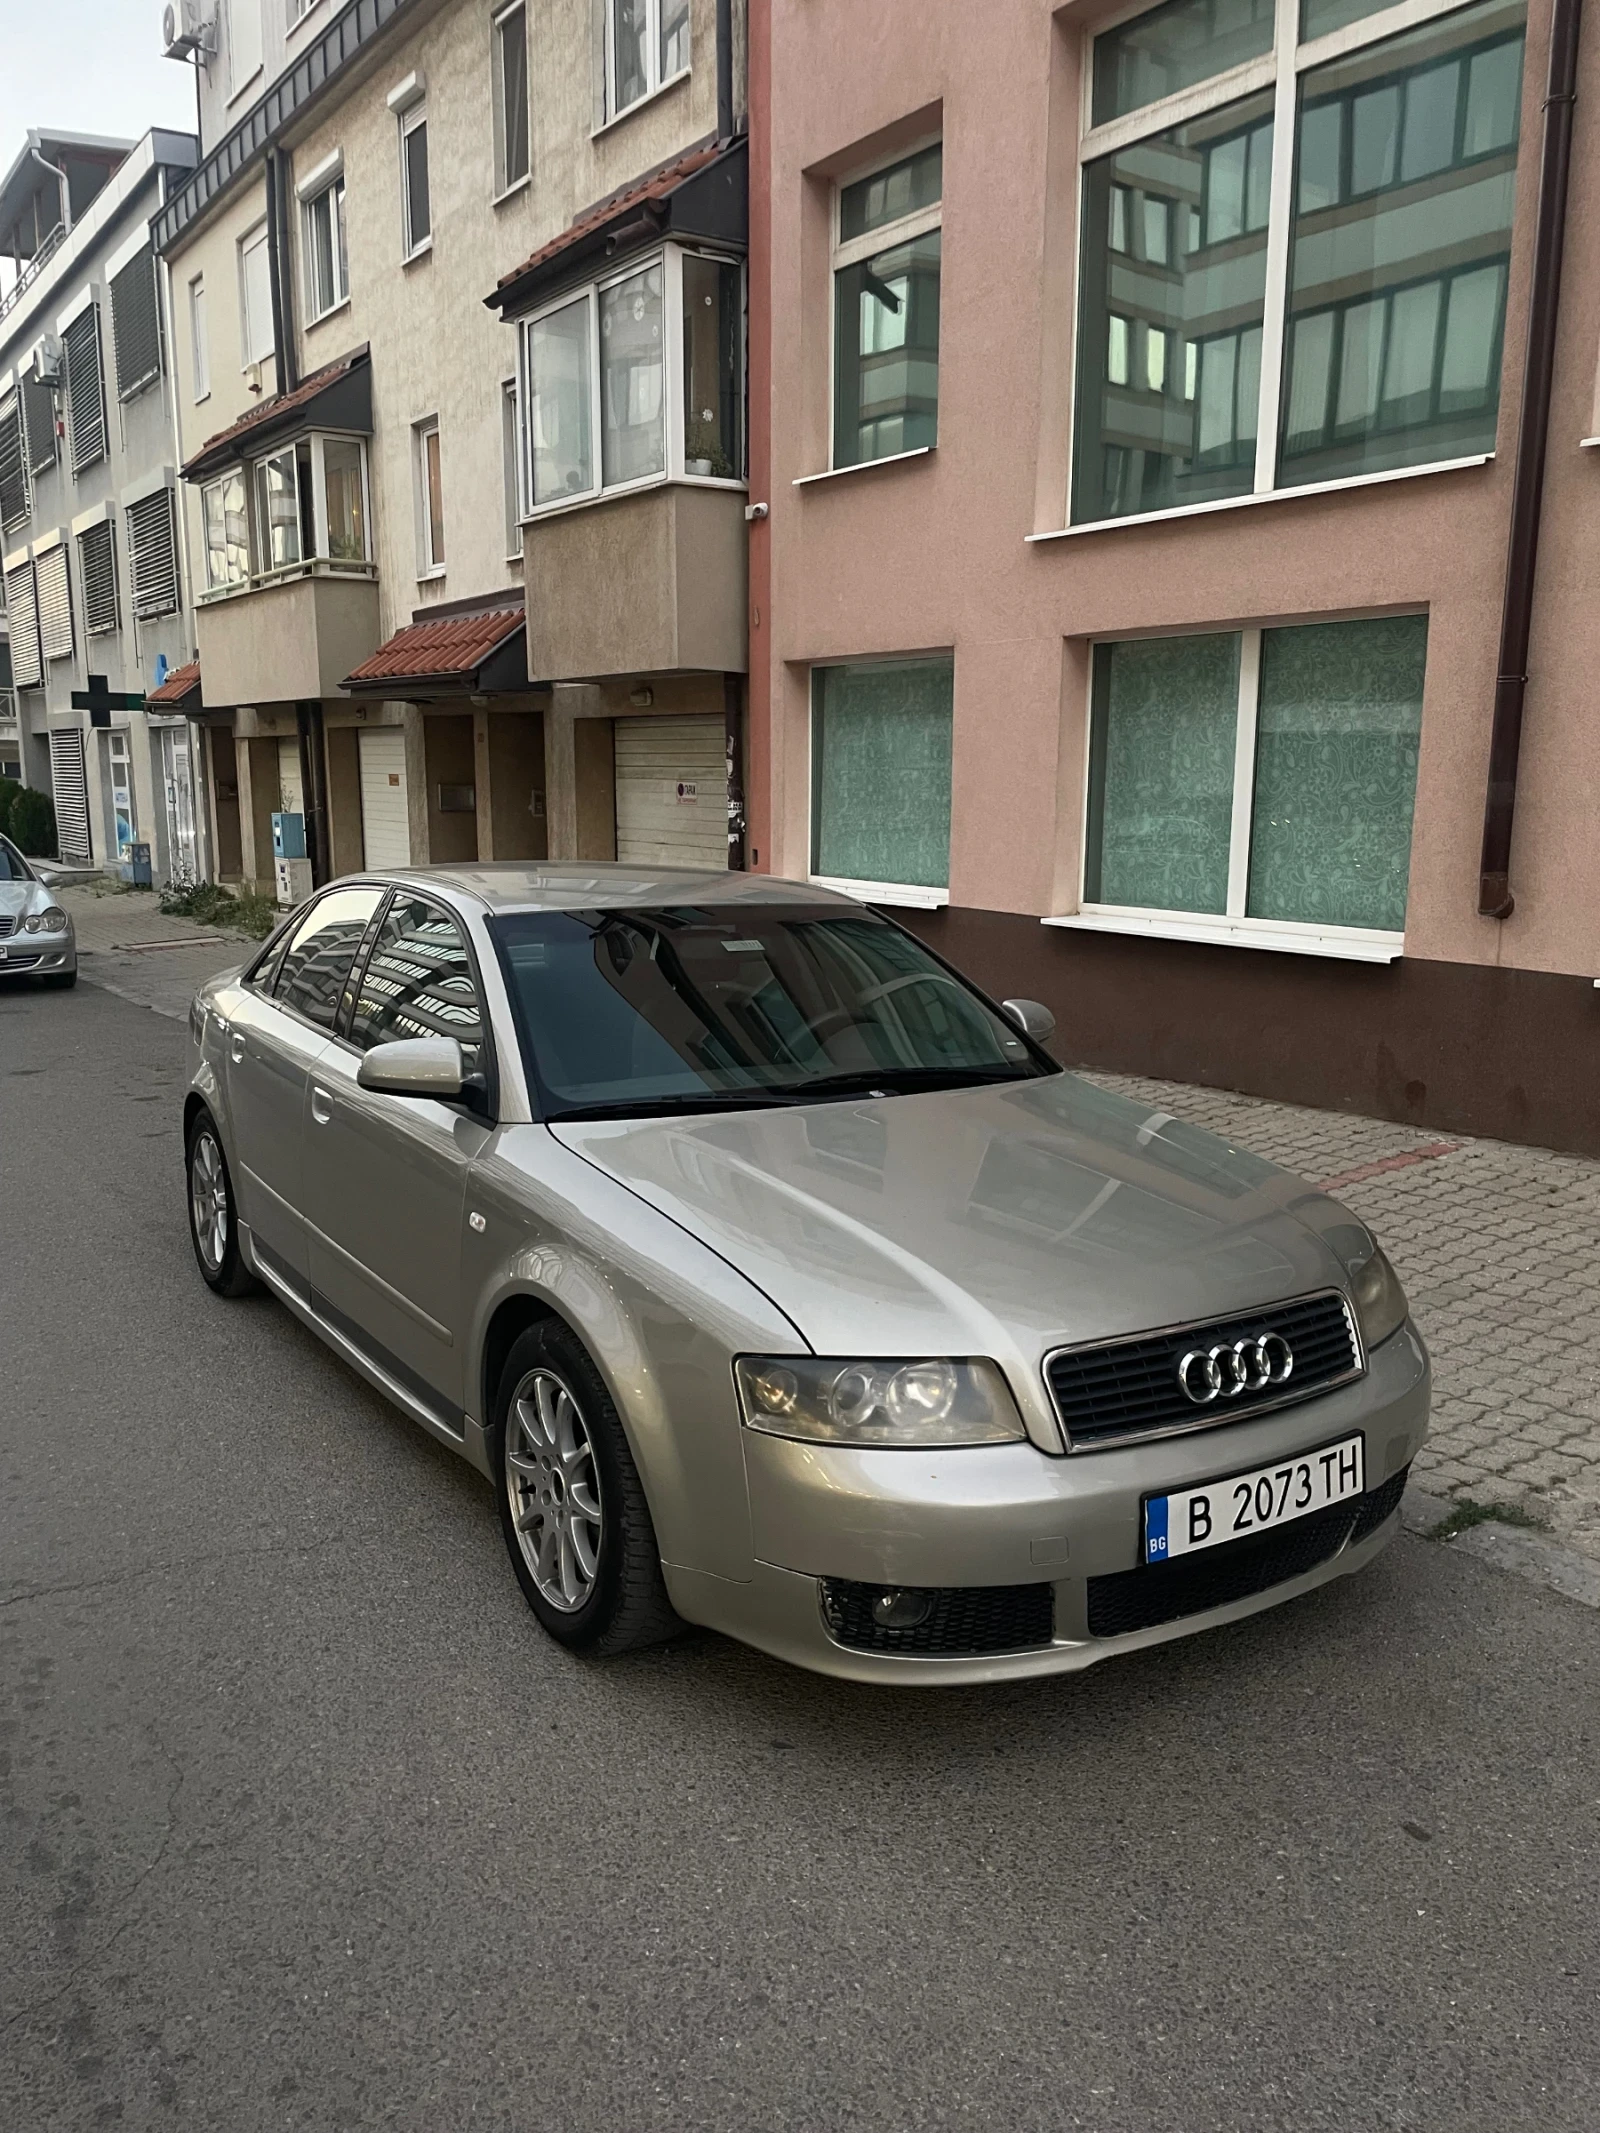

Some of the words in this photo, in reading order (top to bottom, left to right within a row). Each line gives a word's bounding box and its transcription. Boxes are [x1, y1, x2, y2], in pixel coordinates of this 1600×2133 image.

[1189, 1495, 1212, 1544] B
[1232, 1463, 1312, 1531] 2073
[1319, 1444, 1357, 1498] TH
[1150, 1536, 1166, 1552] BG
